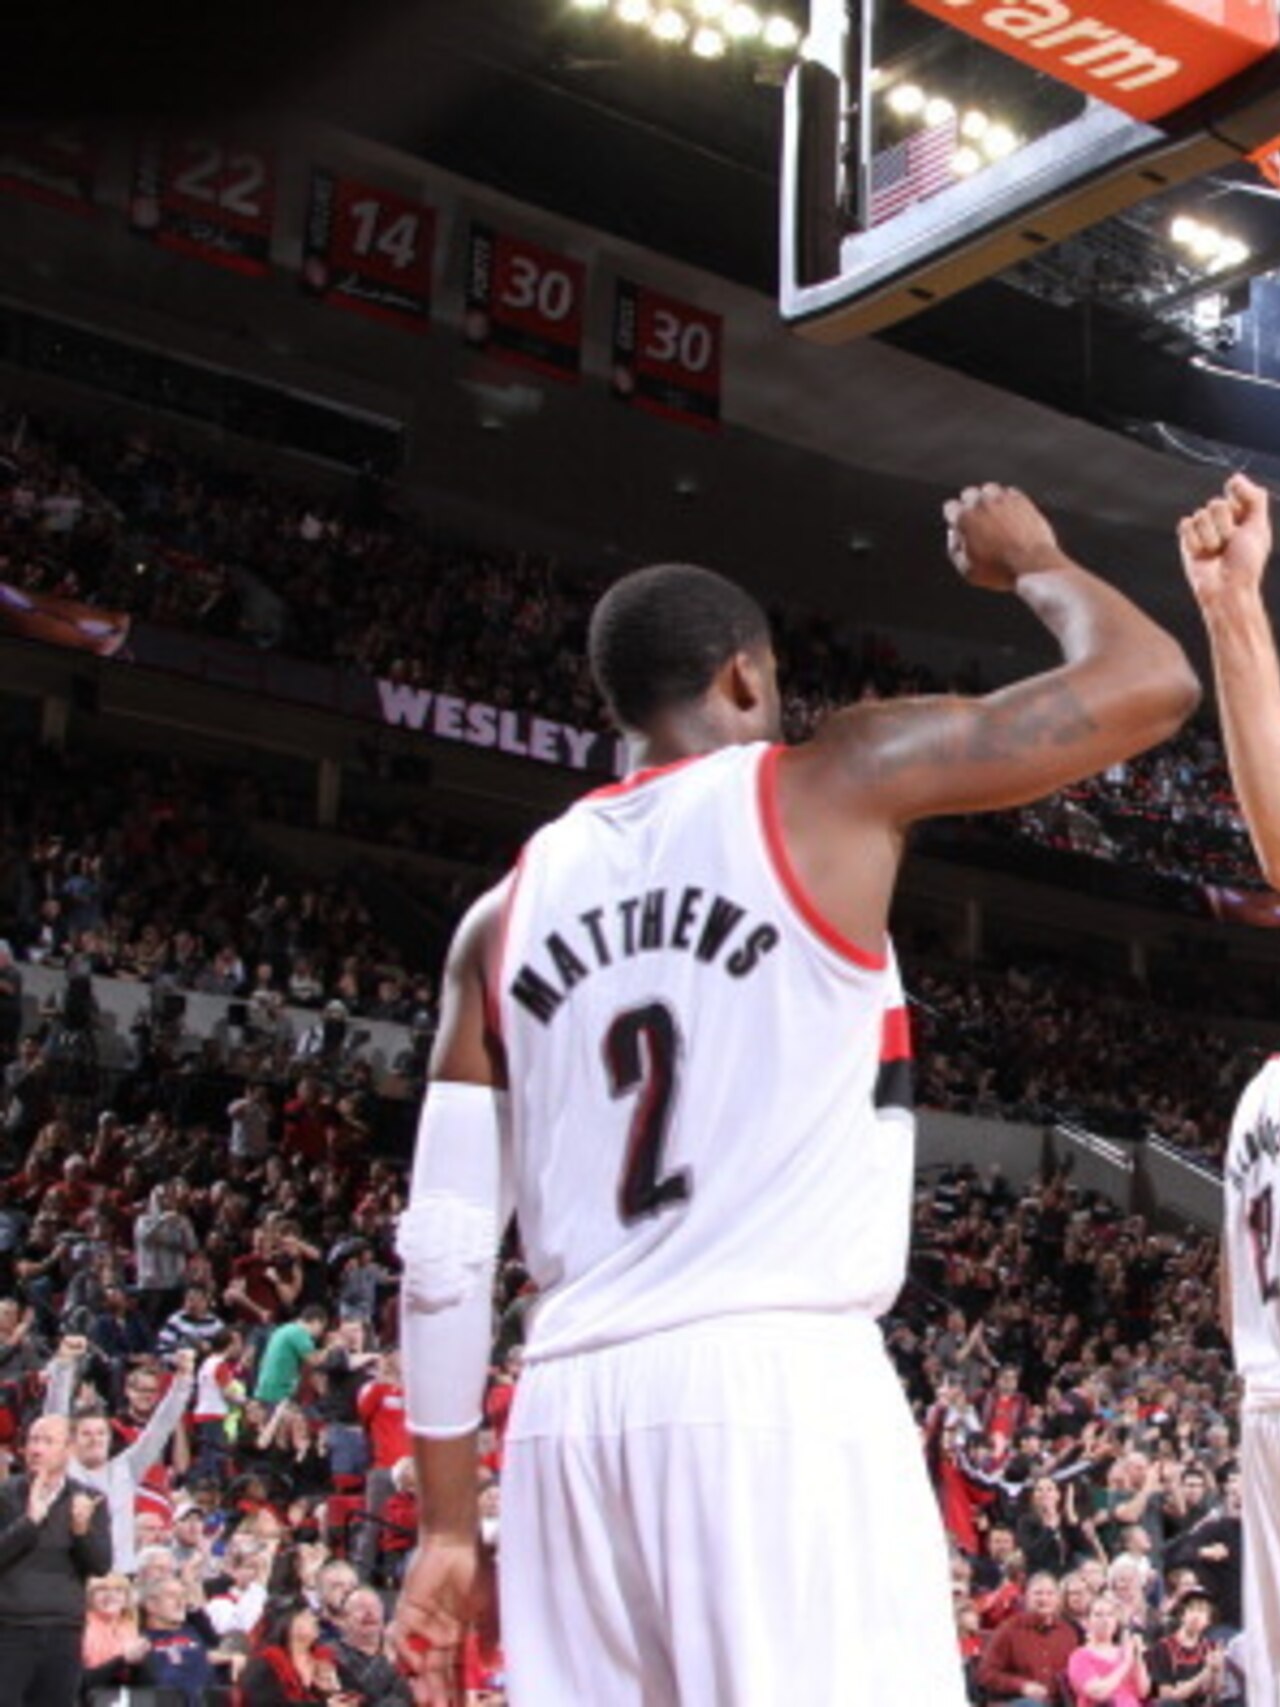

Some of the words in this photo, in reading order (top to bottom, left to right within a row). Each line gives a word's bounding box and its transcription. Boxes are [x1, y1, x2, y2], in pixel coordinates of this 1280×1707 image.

[944, 0, 1181, 91] arm
[174, 139, 263, 218] 22
[349, 200, 418, 268] 14
[502, 256, 572, 321] 30
[645, 311, 711, 373] 30
[376, 679, 597, 769] WESLEY
[510, 885, 780, 1028] MATTHEWS
[600, 997, 694, 1230] 2
